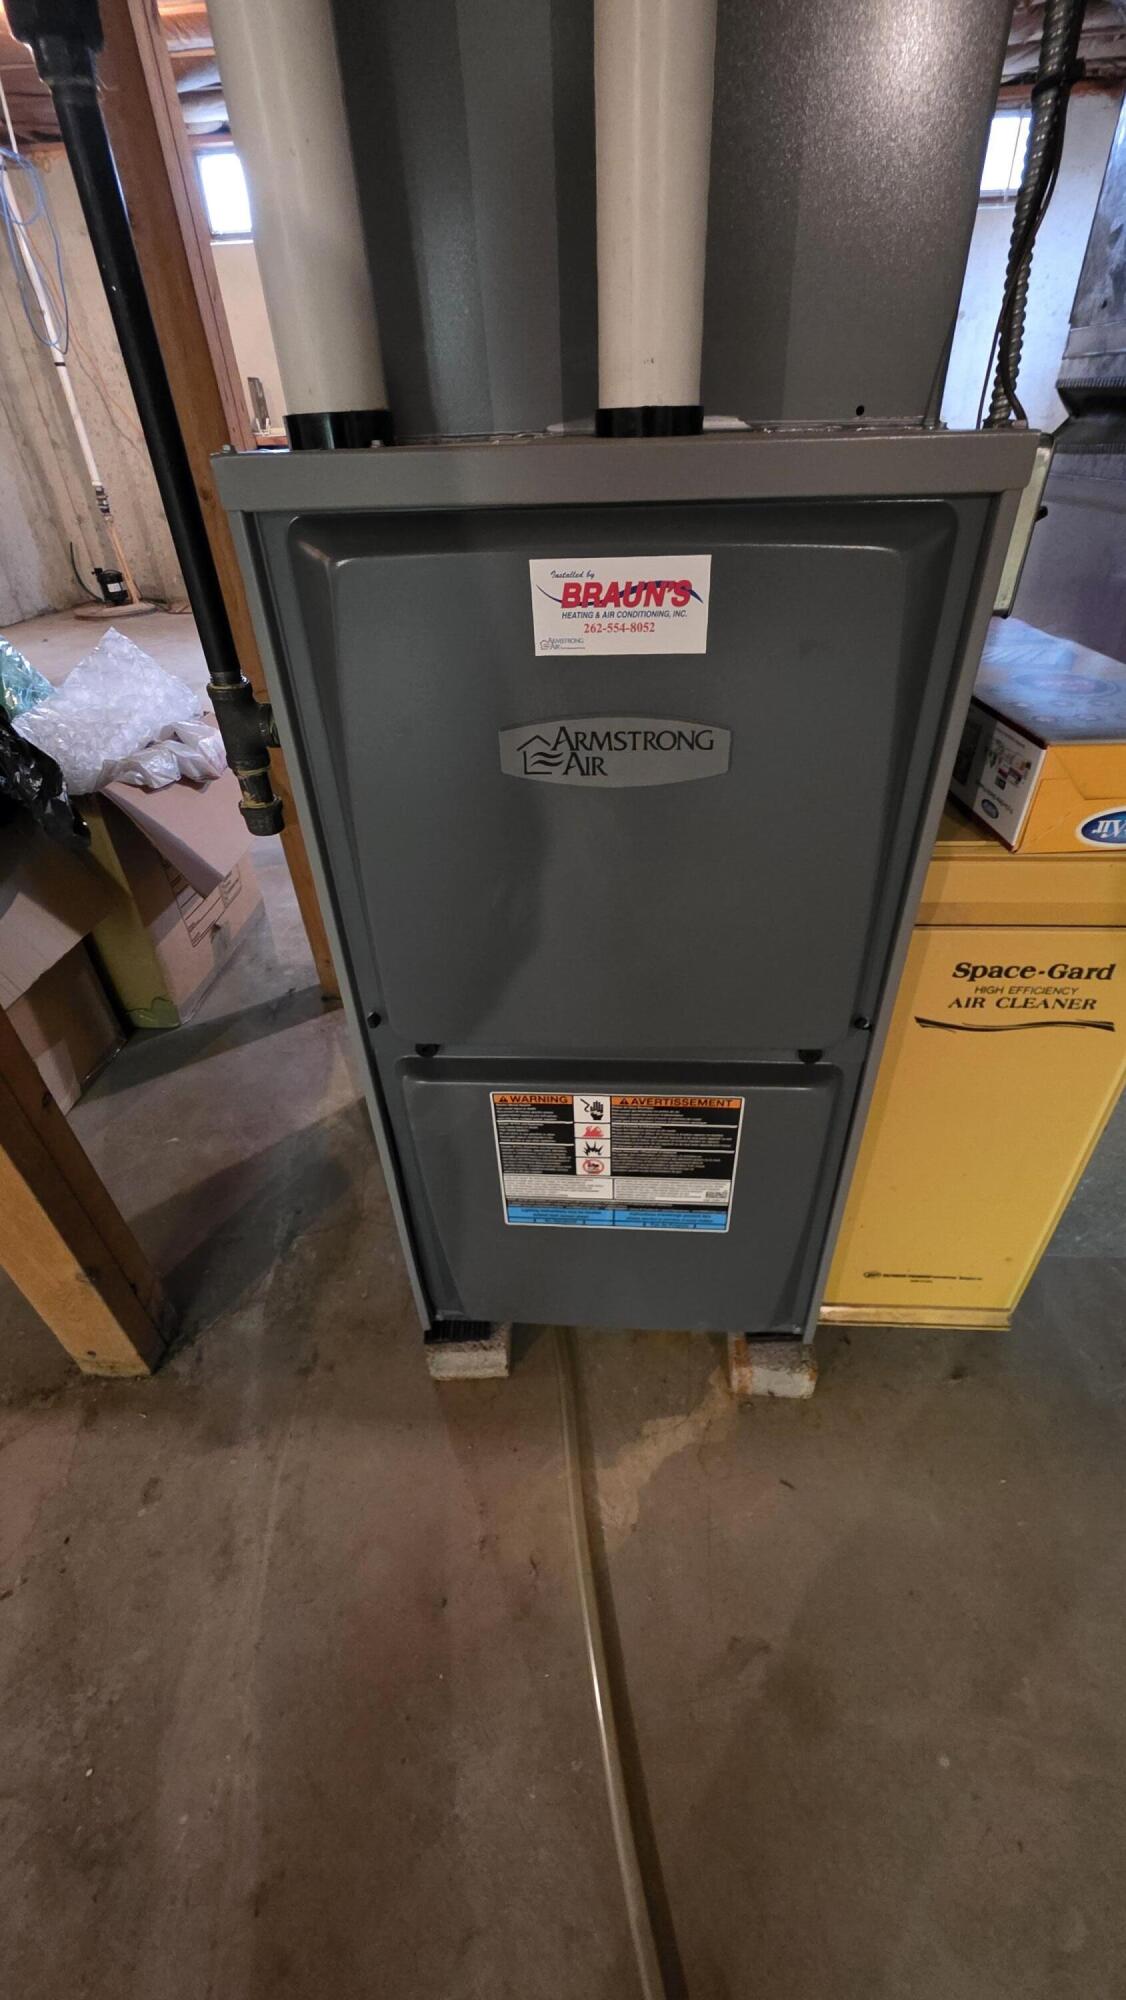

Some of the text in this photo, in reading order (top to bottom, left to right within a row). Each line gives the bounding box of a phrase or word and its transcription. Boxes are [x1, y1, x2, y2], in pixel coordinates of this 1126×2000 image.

[550, 569, 595, 579] Installed by
[561, 580, 692, 608] BRAUN'S
[561, 610, 688, 619] HEATING & AIR CONDITIONING, INC.
[584, 622, 655, 633] 262-554-8052
[551, 726, 714, 751] ARMSTRONG
[562, 751, 608, 776] AIR
[952, 962, 1116, 982] Space-Gard
[974, 986, 1079, 995] HIGH EFFICIENCY
[948, 997, 1097, 1010] AIR CLEANER
[510, 1095, 568, 1104] WARNING
[631, 1097, 732, 1107] AVERTISSEMENT
